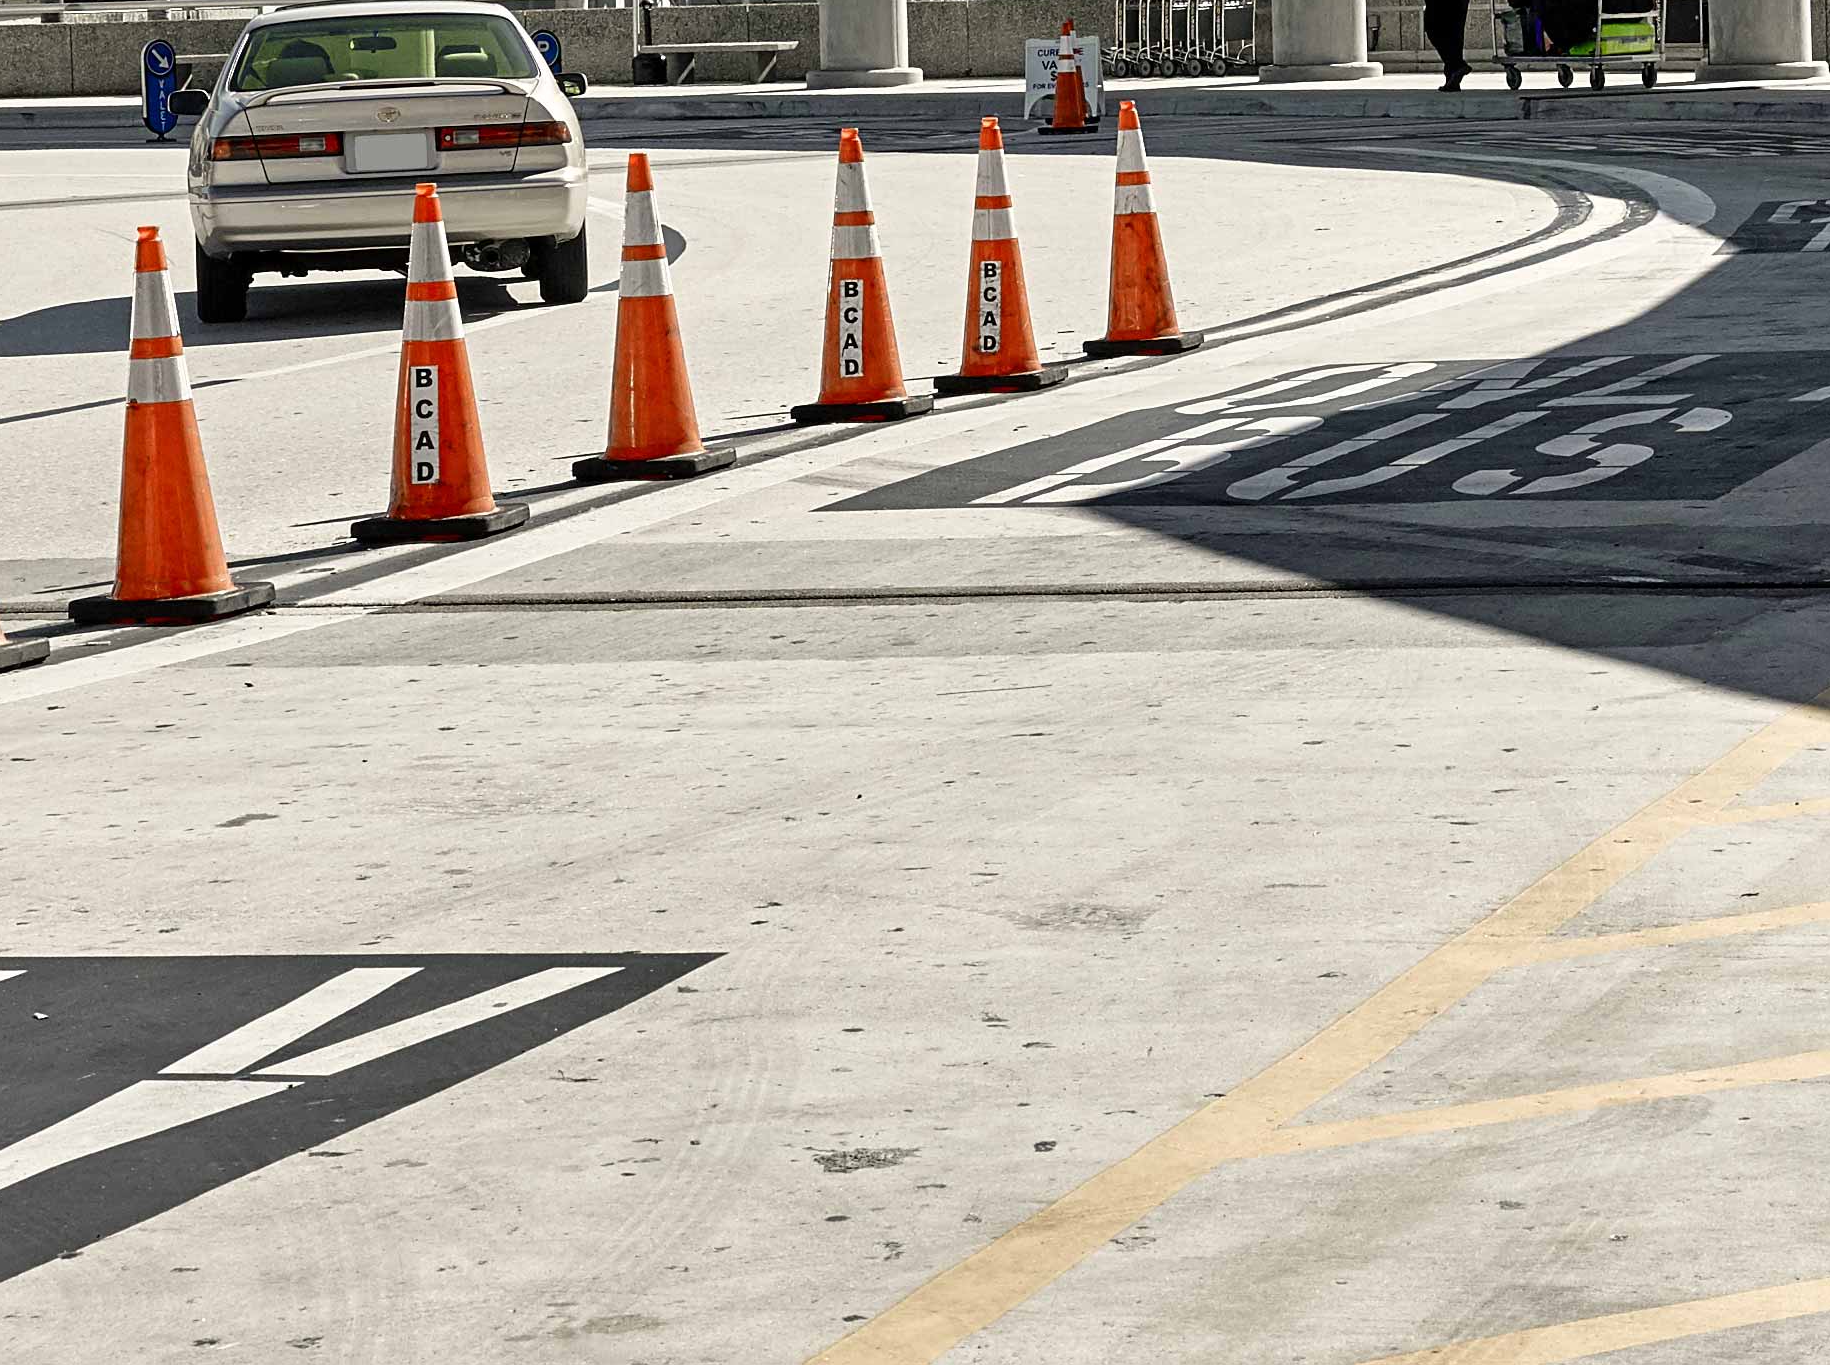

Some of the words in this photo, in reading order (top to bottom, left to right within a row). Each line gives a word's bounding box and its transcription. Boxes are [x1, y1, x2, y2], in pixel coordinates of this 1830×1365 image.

[537, 40, 550, 53] P
[158, 79, 167, 132] VALET
[843, 281, 859, 375] BCAD
[982, 262, 997, 351] BCAD
[415, 368, 435, 481] BCAD
[969, 407, 1733, 504] BUS
